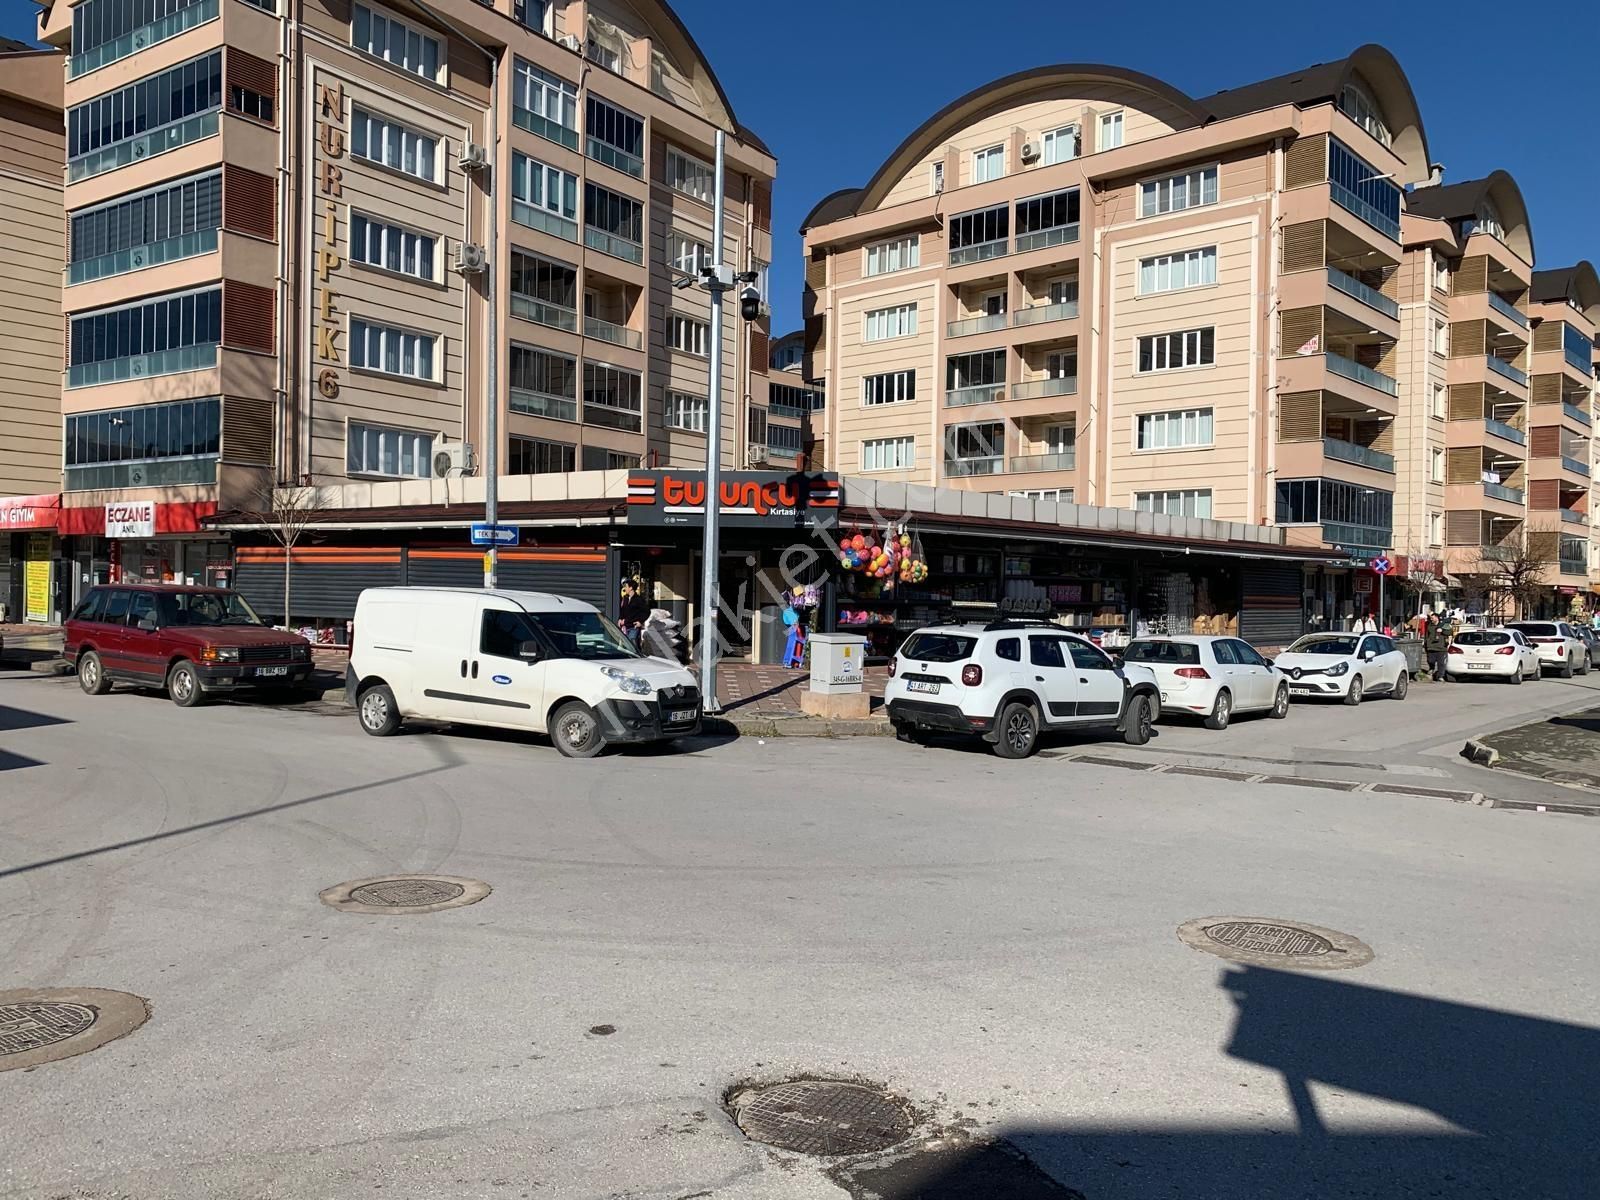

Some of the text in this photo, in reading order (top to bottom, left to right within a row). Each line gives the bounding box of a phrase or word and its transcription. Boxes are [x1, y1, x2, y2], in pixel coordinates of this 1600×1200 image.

[319, 367, 340, 399] 6
[663, 475, 799, 515] tuuncu
[107, 507, 150, 523] ECZANE
